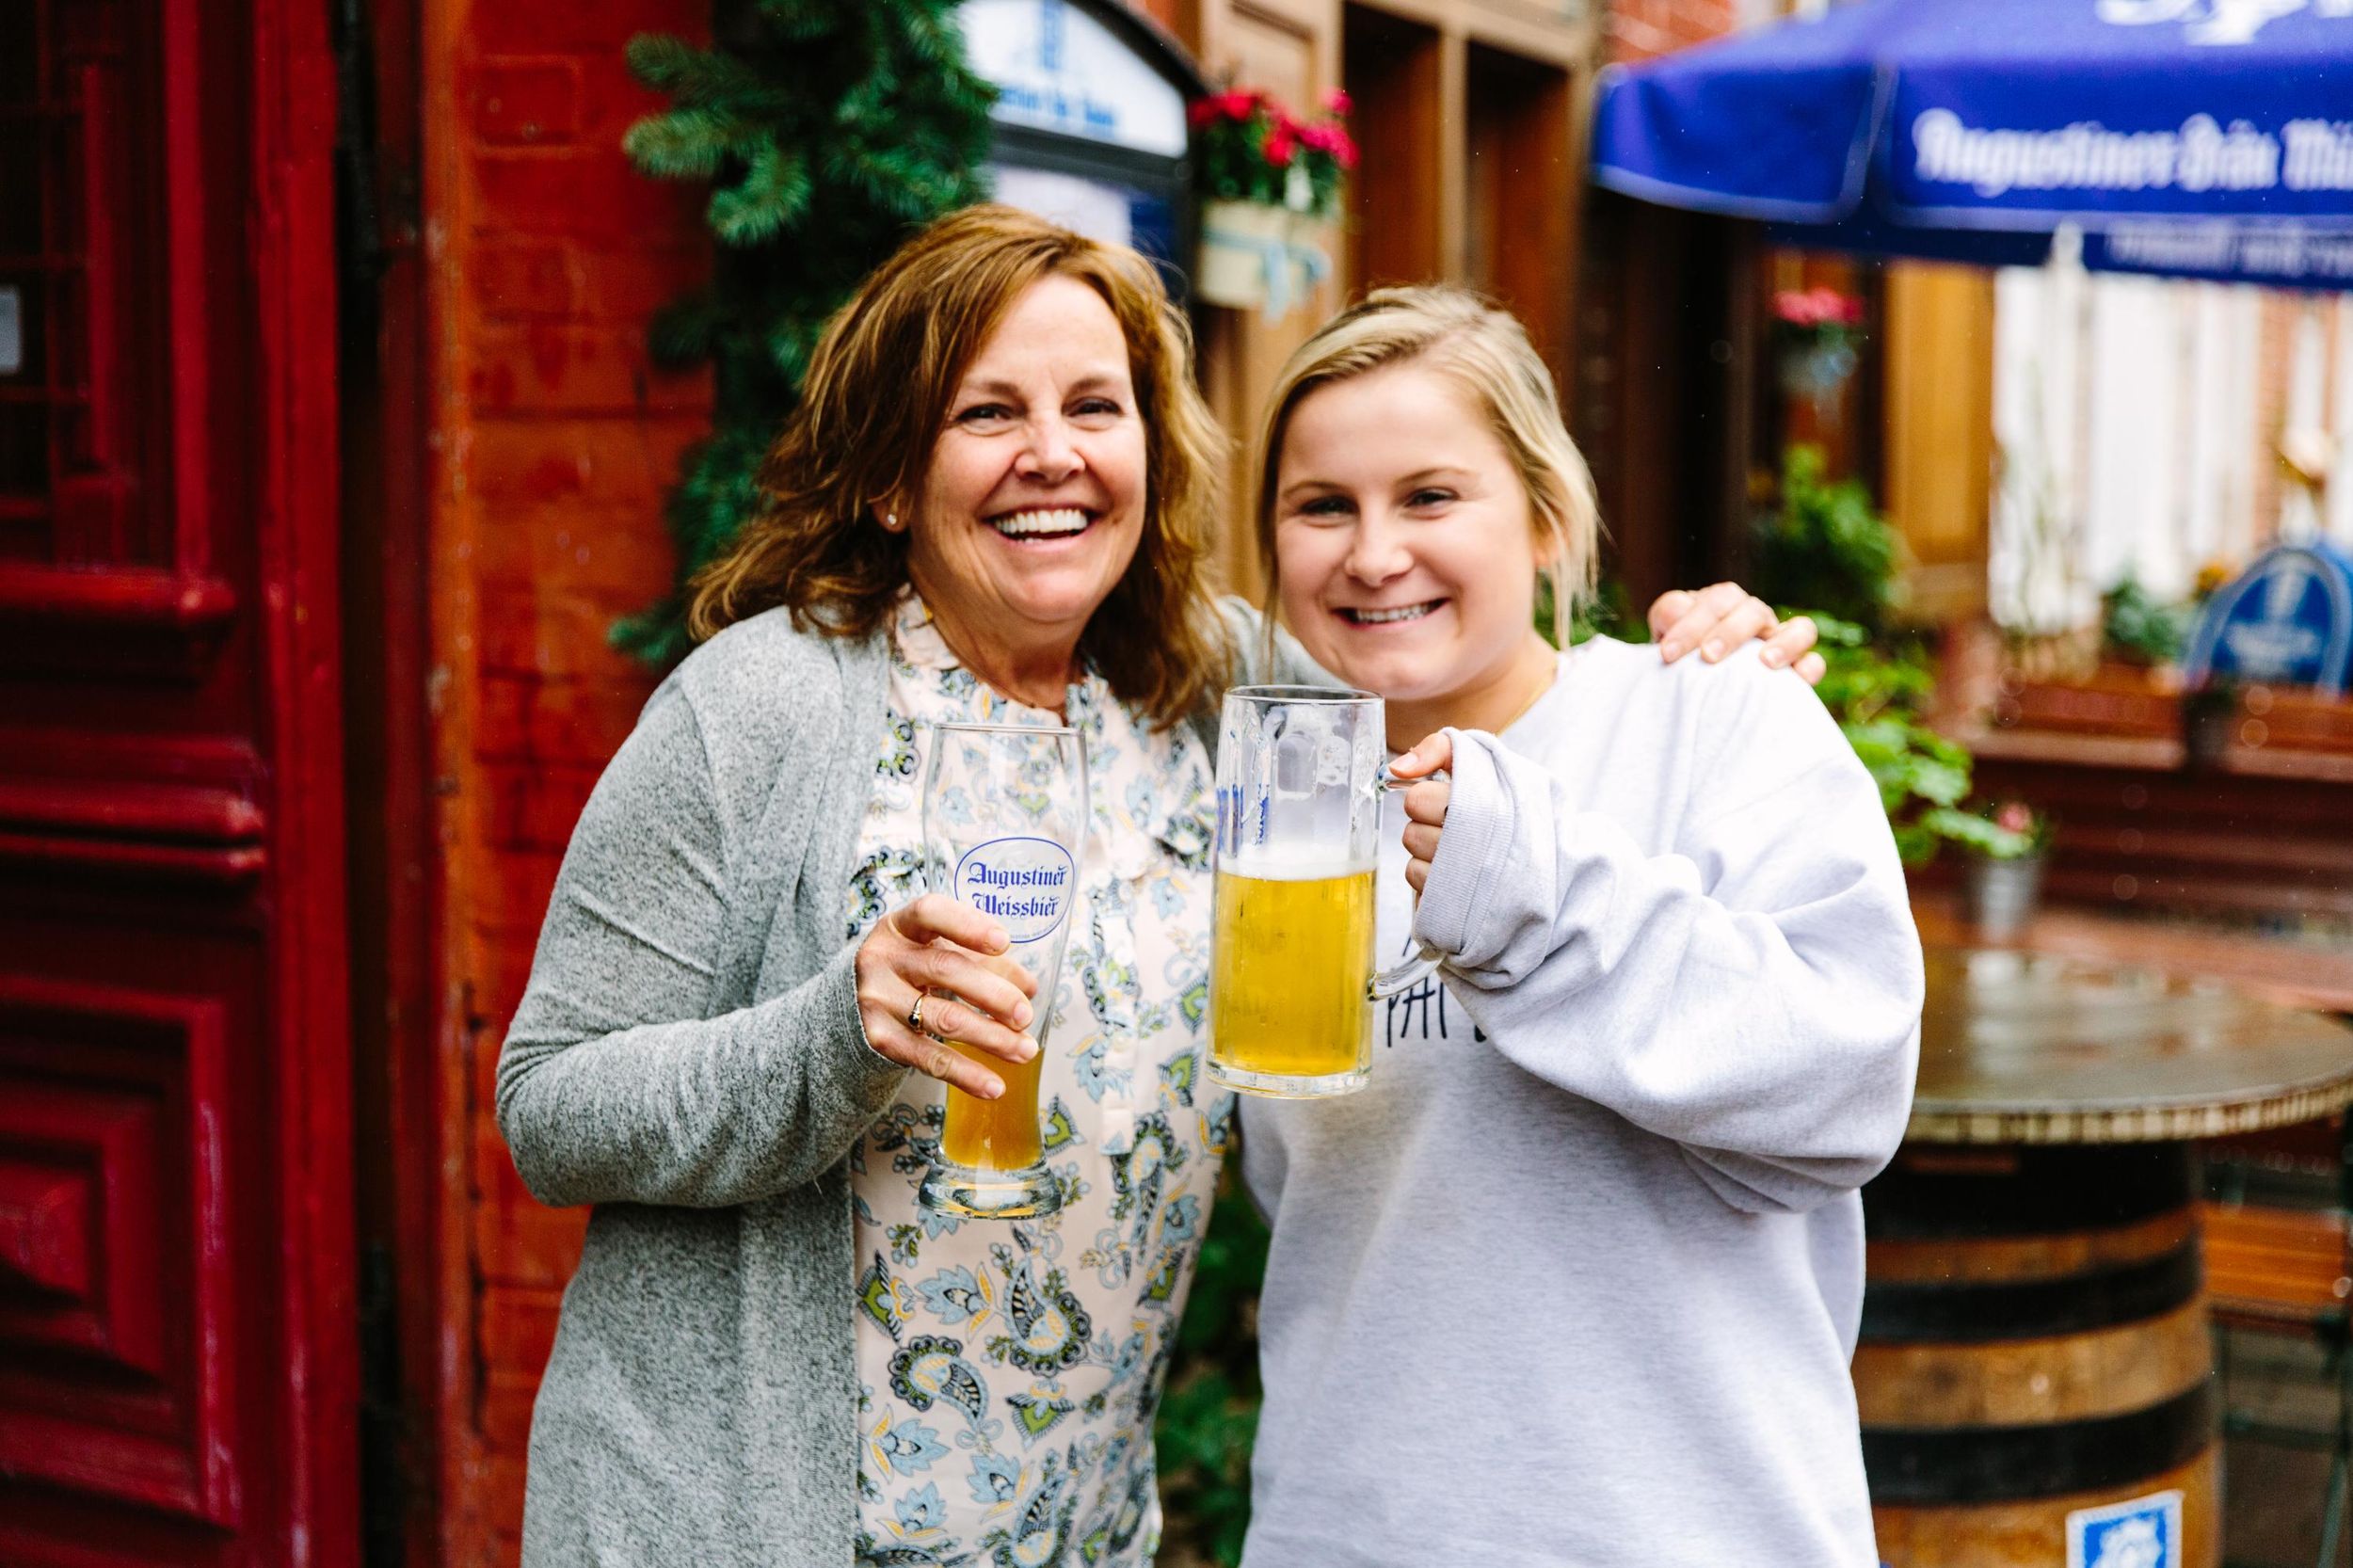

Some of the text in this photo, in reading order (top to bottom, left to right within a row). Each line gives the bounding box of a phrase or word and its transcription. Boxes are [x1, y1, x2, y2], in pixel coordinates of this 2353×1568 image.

[1913, 108, 2175, 198] Augustiner
[968, 862, 1068, 889] Augustiner
[971, 892, 1061, 920] Weissbier
